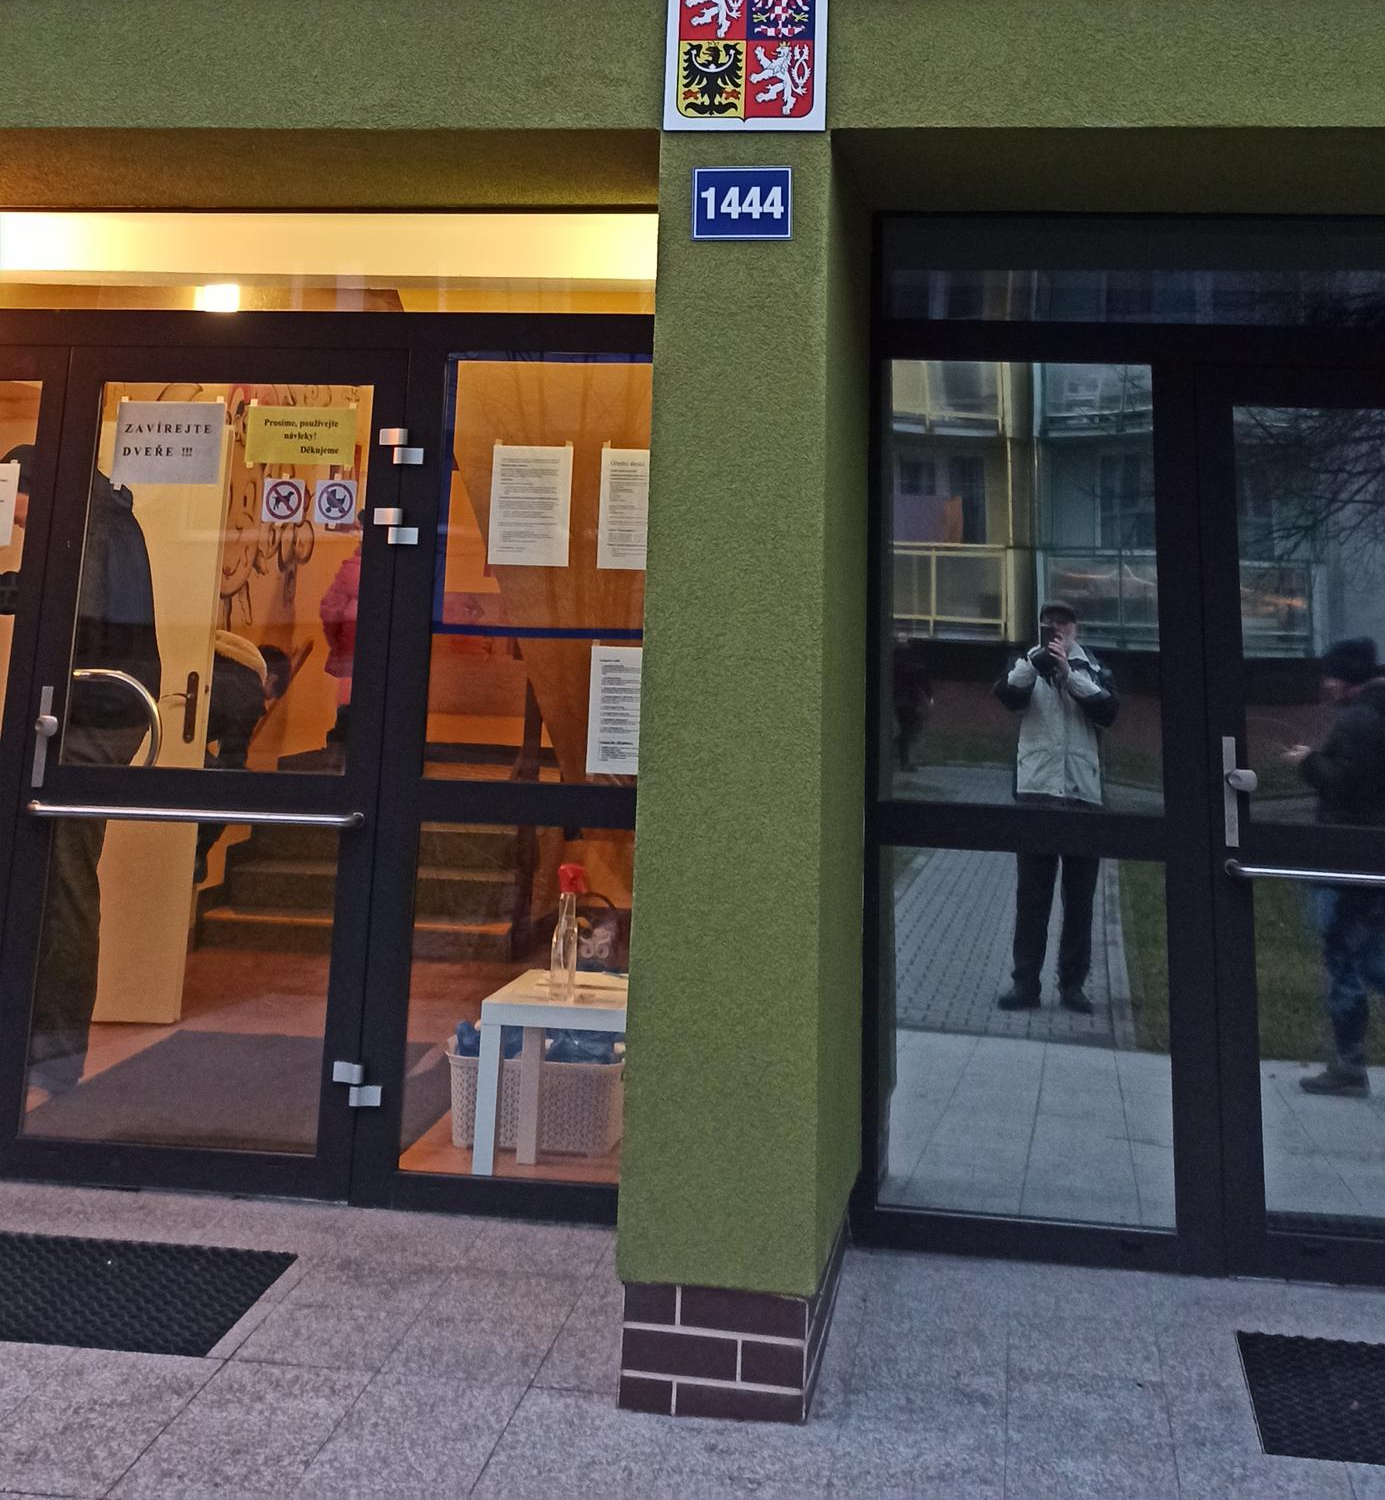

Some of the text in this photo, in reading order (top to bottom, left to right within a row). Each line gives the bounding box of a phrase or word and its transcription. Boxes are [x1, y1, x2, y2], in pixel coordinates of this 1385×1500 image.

[700, 185, 785, 220] 1444
[124, 420, 213, 434] ZAVÍREJTE
[122, 444, 193, 457] DVEŘE !!!
[300, 445, 340, 456] Děkujeme
